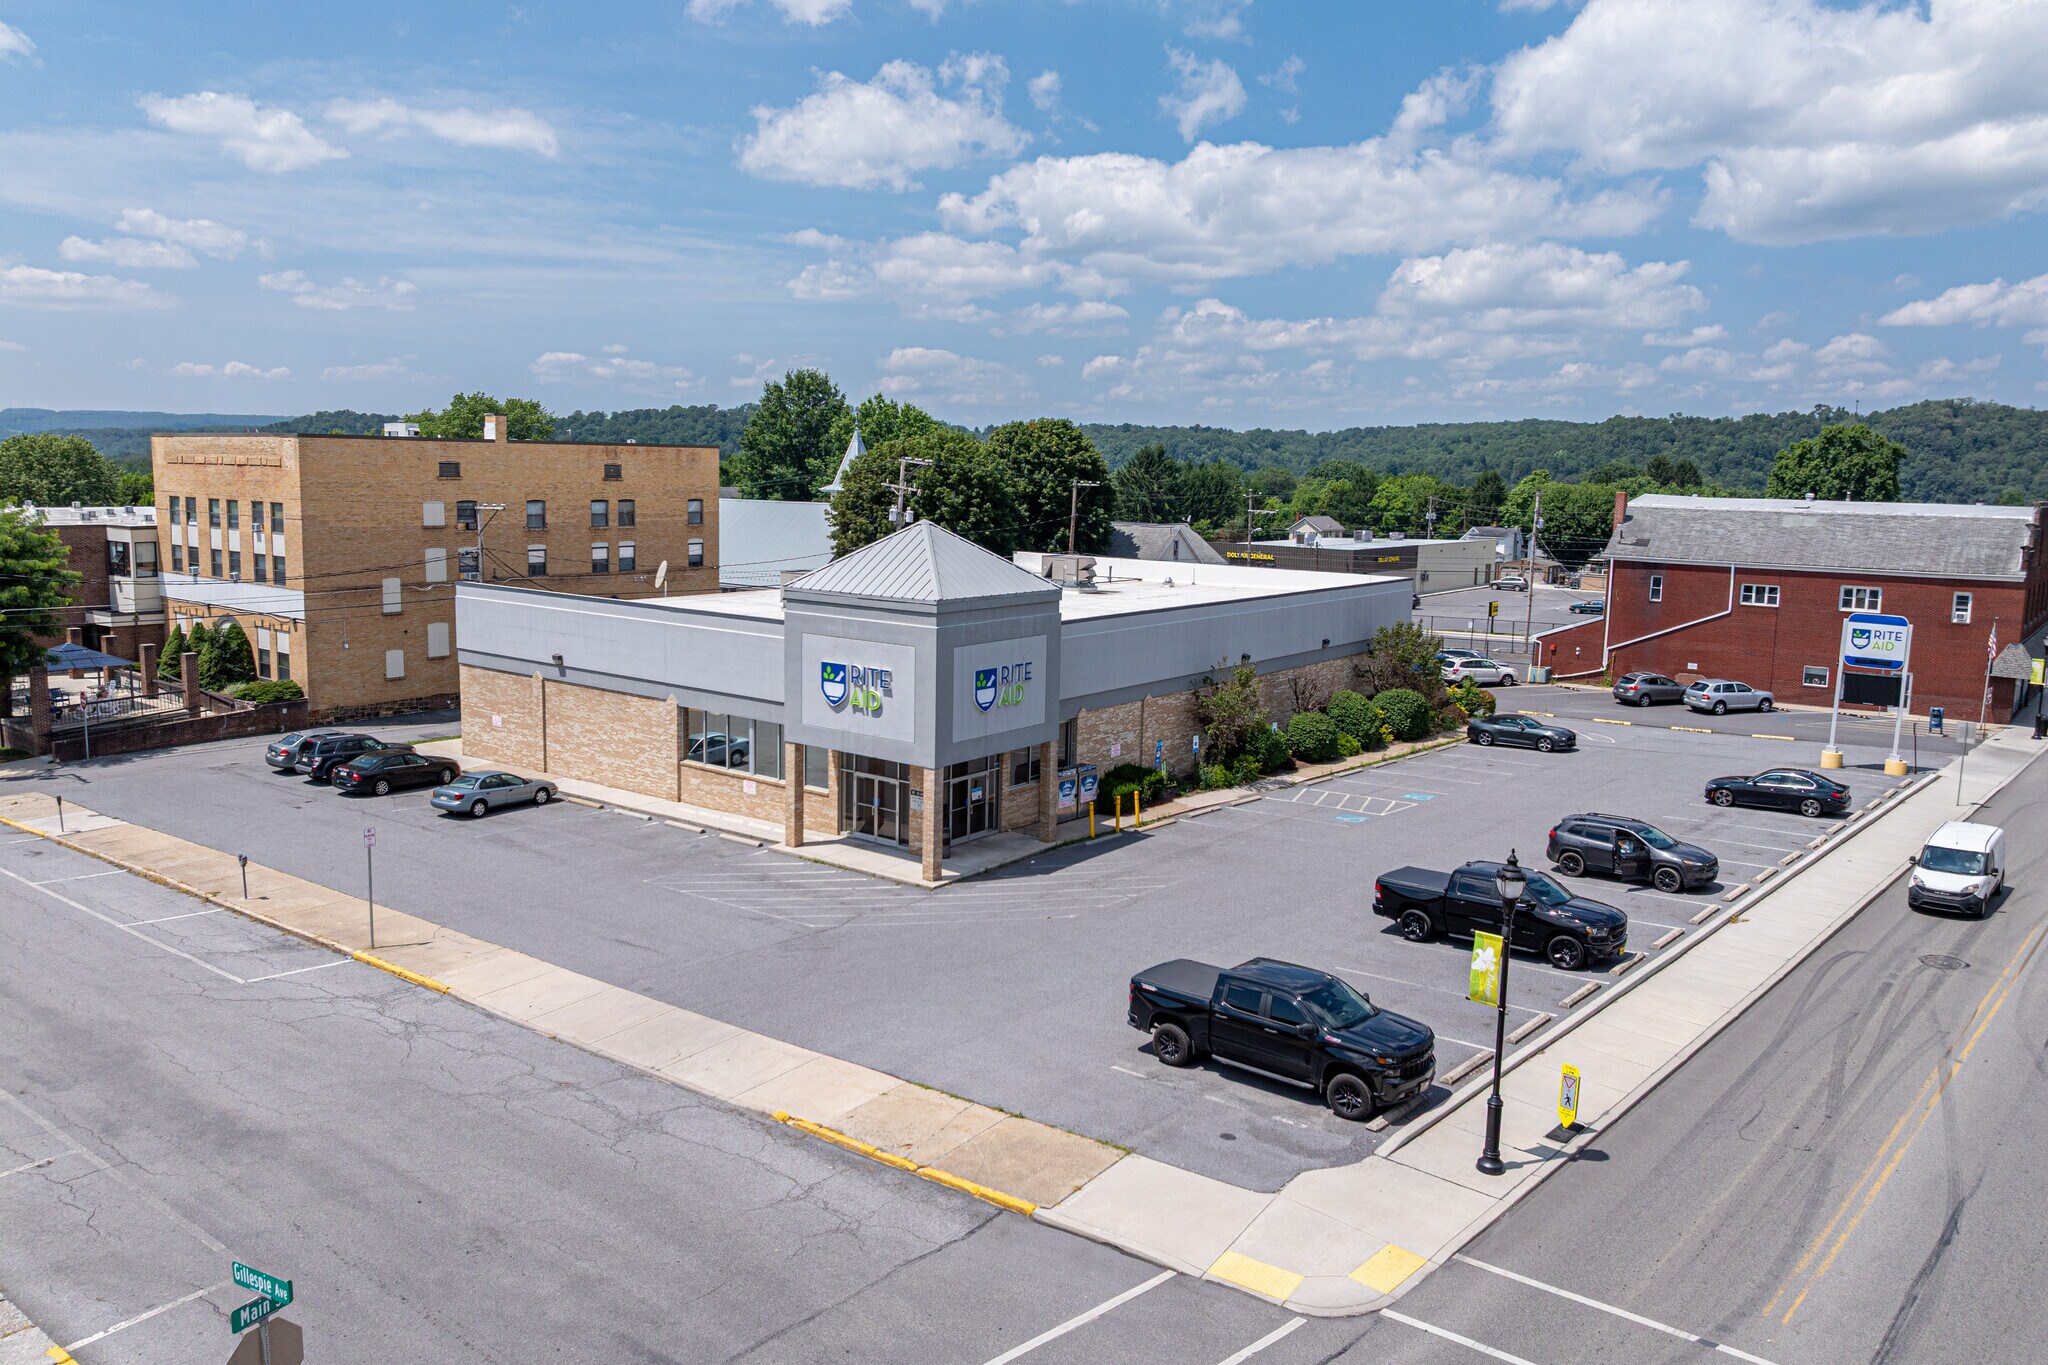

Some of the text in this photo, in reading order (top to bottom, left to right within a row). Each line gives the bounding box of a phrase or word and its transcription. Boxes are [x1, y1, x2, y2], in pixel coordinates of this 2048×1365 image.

[1872, 641, 1895, 652] AID
[1874, 629, 1903, 642] RITE
[850, 664, 892, 690] RITE
[1001, 661, 1032, 685] RITE
[850, 689, 882, 711] AID
[998, 684, 1025, 708] AID
[233, 1263, 288, 1300] Gillespie Ave
[240, 1299, 270, 1327] Main
